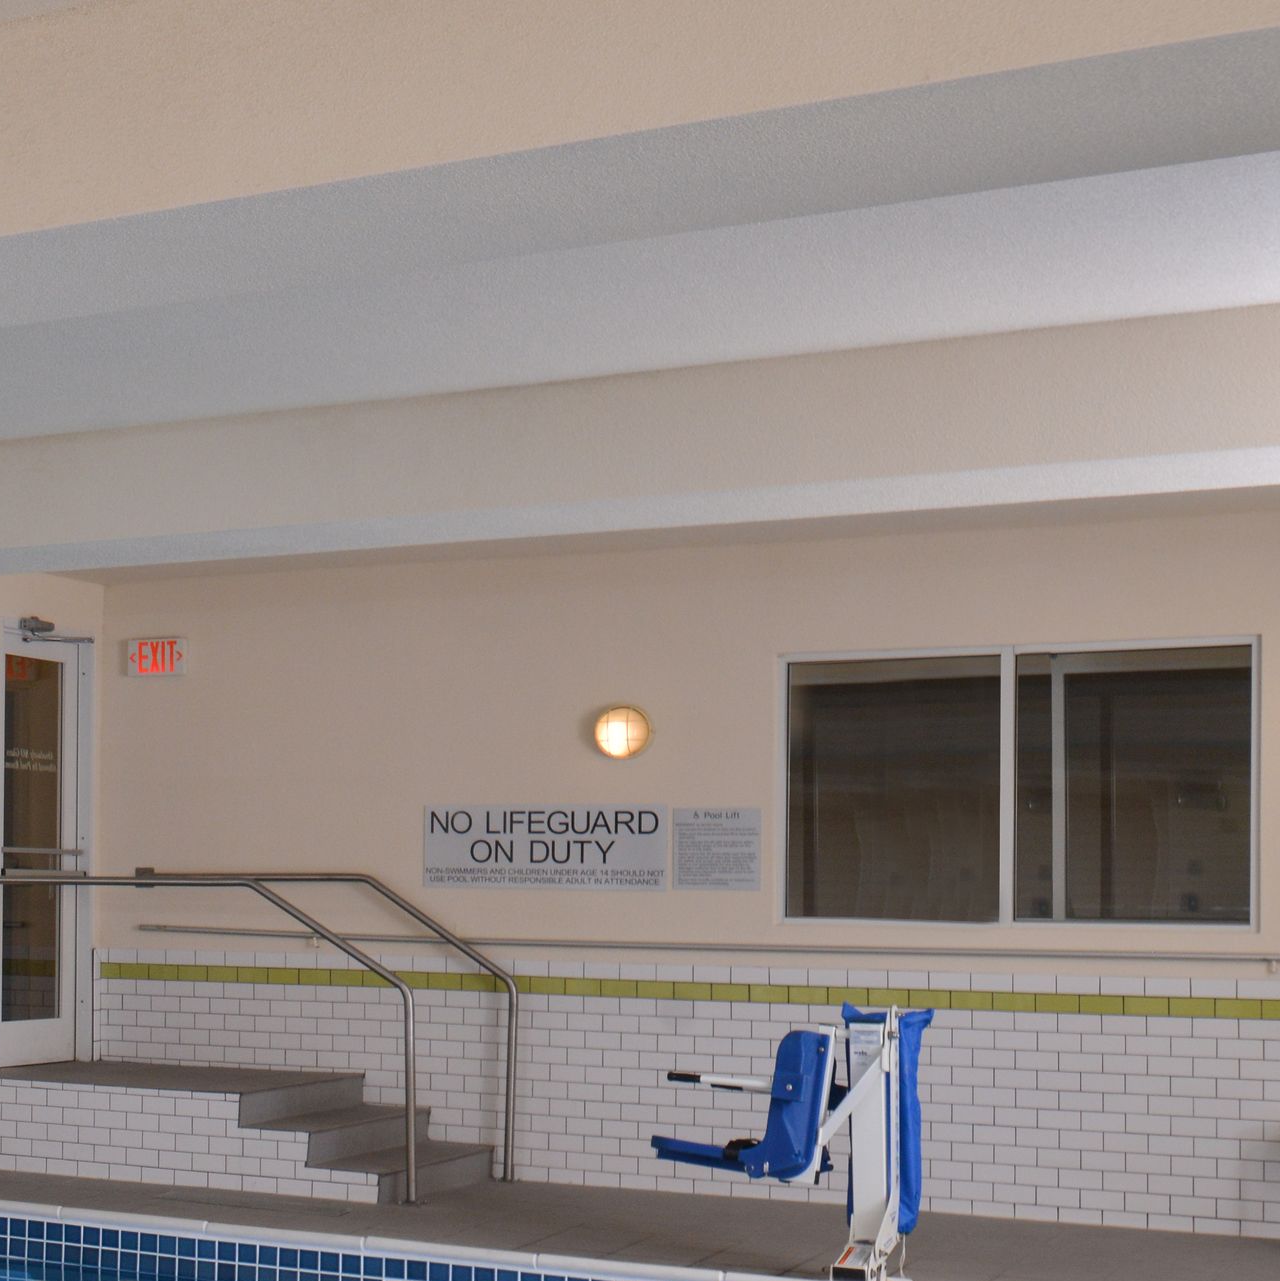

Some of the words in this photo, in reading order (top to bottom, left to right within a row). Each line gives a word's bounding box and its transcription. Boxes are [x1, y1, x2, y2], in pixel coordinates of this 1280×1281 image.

[138, 640, 177, 673] EXIT
[430, 810, 473, 834] NO
[486, 810, 659, 835] LIFEGUARD
[704, 811, 722, 819] Pool
[470, 839, 514, 864] ON
[530, 840, 615, 865] DUTY
[508, 868, 548, 876] CHILDREN
[550, 868, 578, 876] UNDER
[611, 869, 645, 877] SHOULD
[647, 870, 665, 878] NOT
[566, 877, 591, 885] ADULT
[604, 878, 660, 886] ATTENDANCE
